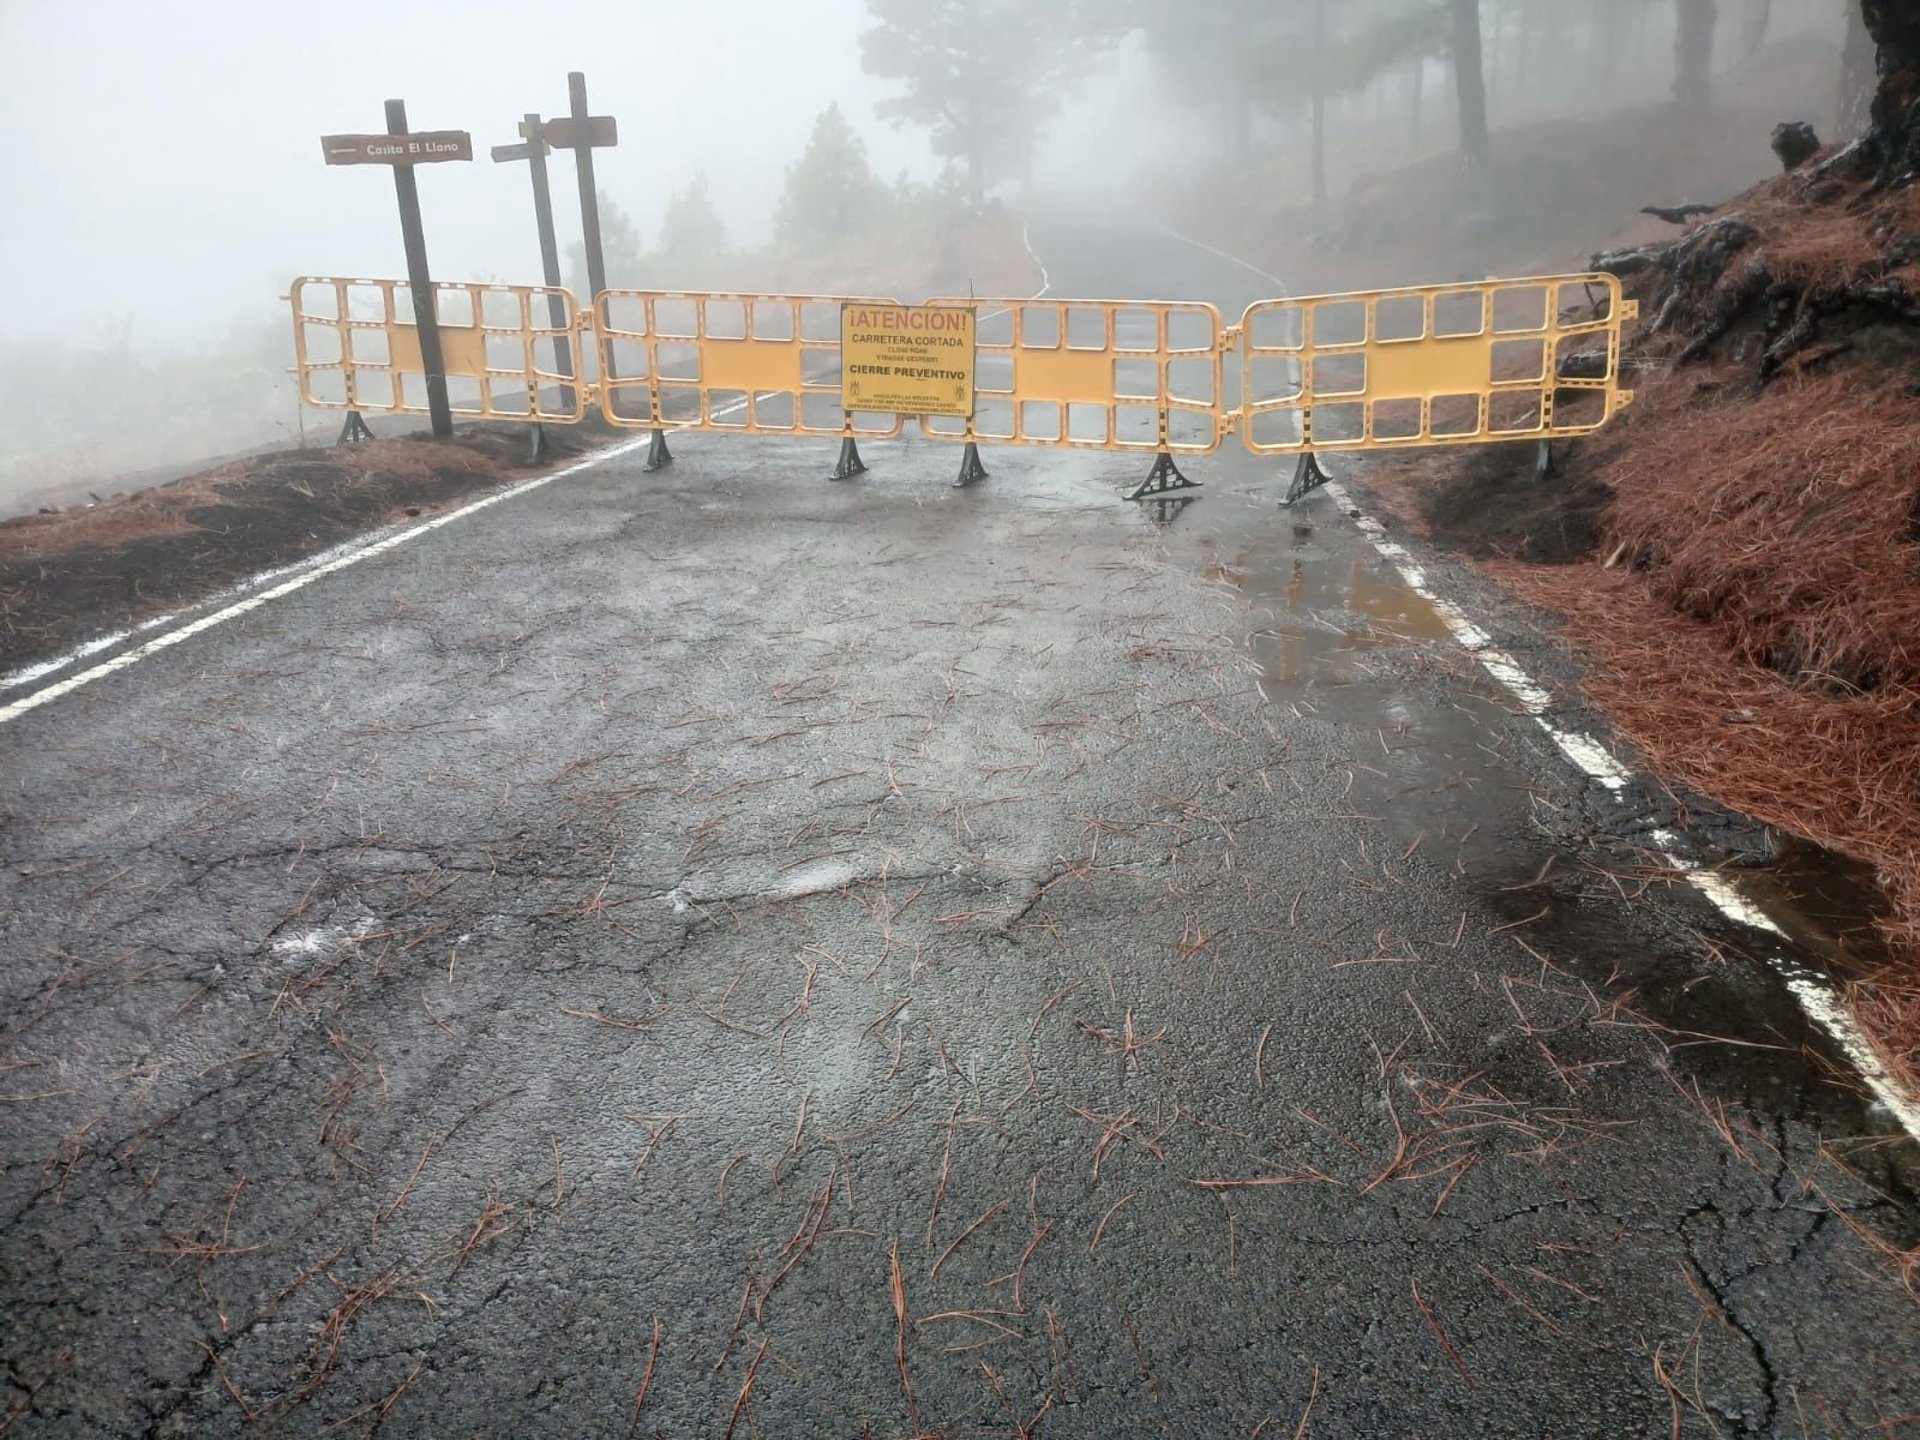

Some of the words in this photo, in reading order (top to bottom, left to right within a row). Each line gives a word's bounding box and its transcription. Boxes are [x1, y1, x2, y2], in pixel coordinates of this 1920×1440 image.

[367, 144, 403, 155] Casita
[409, 143, 420, 153] El
[426, 142, 458, 152] Llano
[850, 309, 967, 331] ¡ATENCIÓN!
[852, 334, 912, 345] CARRETERA
[915, 336, 963, 347] CORTADA
[850, 364, 890, 376] CIERRE
[894, 366, 965, 380] PREVENTIVO
